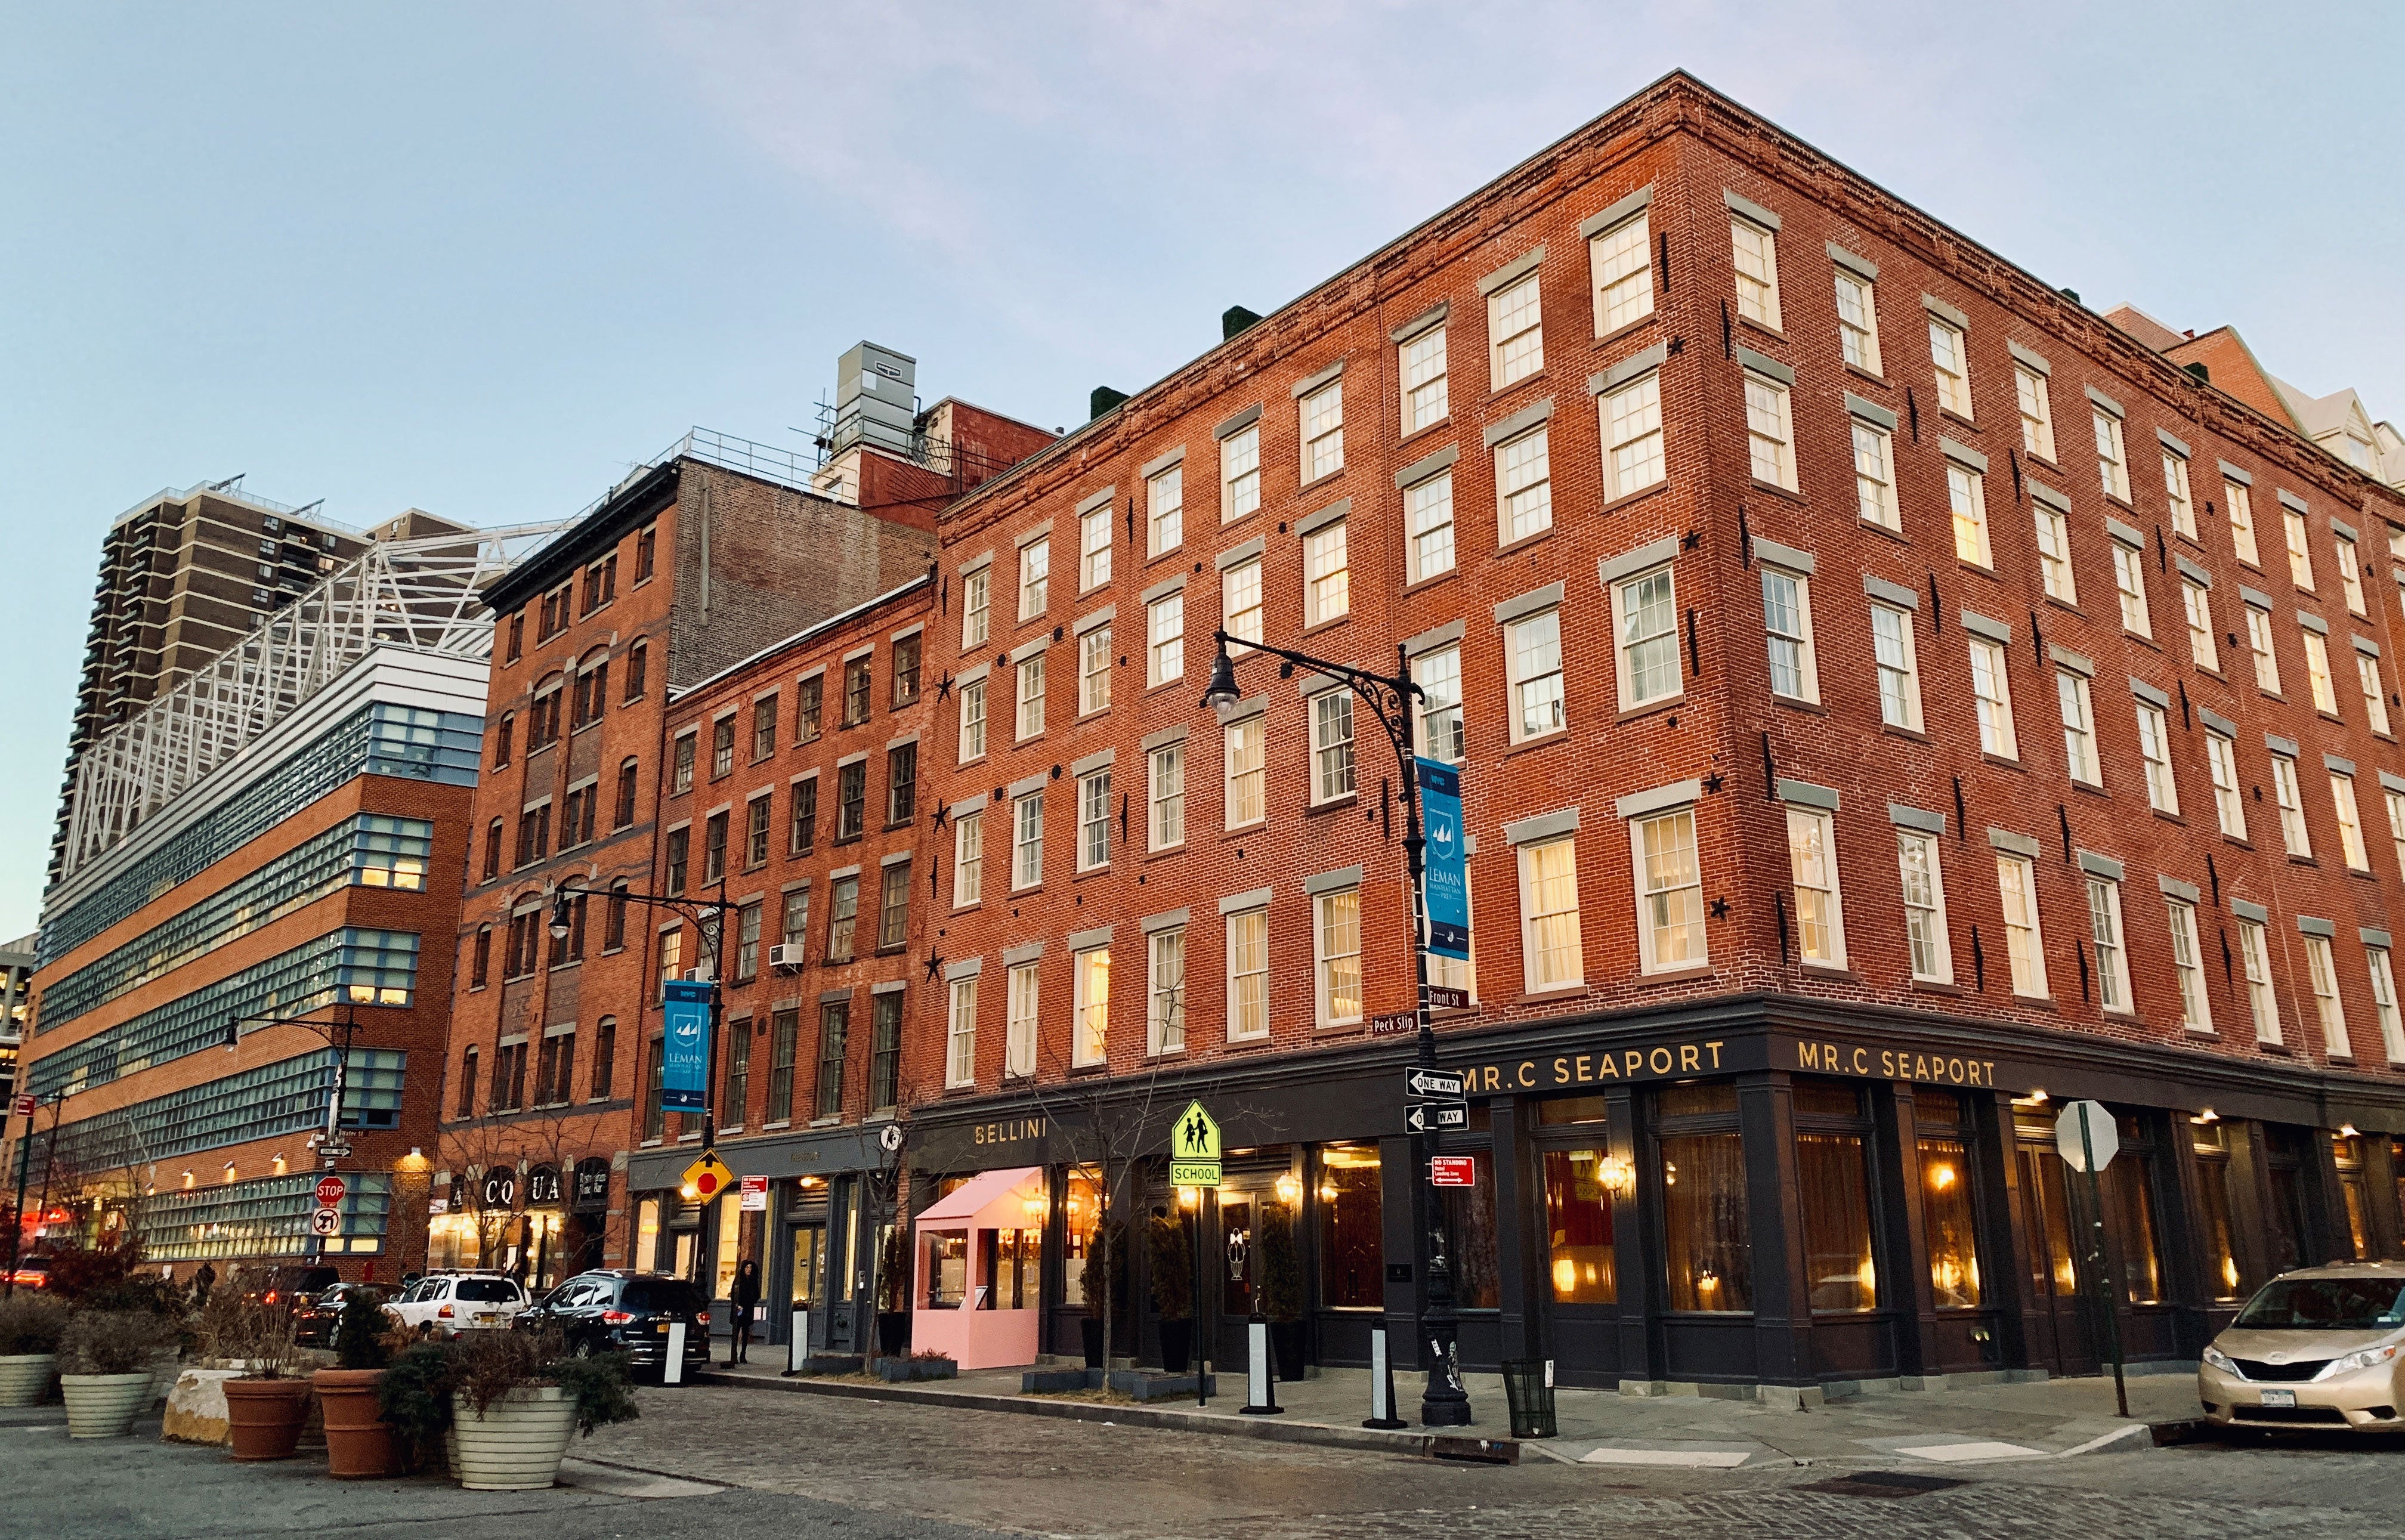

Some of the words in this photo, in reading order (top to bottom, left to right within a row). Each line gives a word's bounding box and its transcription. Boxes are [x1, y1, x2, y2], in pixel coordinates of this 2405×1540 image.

[1430, 991, 1449, 1005] Front
[1451, 994, 1459, 1006] St
[1375, 1018, 1394, 1032] Peck
[1397, 1015, 1414, 1032] Slip
[1554, 1042, 1724, 1084] SEAPORT
[1882, 1050, 1994, 1086] SEAPORT
[1418, 1078, 1435, 1088] ONE
[1439, 1080, 1456, 1090] WAY
[1439, 1112, 1458, 1122] WAY
[975, 1118, 1046, 1144] BELLINI
[1175, 1168, 1217, 1180] SCHOOL
[317, 1185, 344, 1196] STOP
